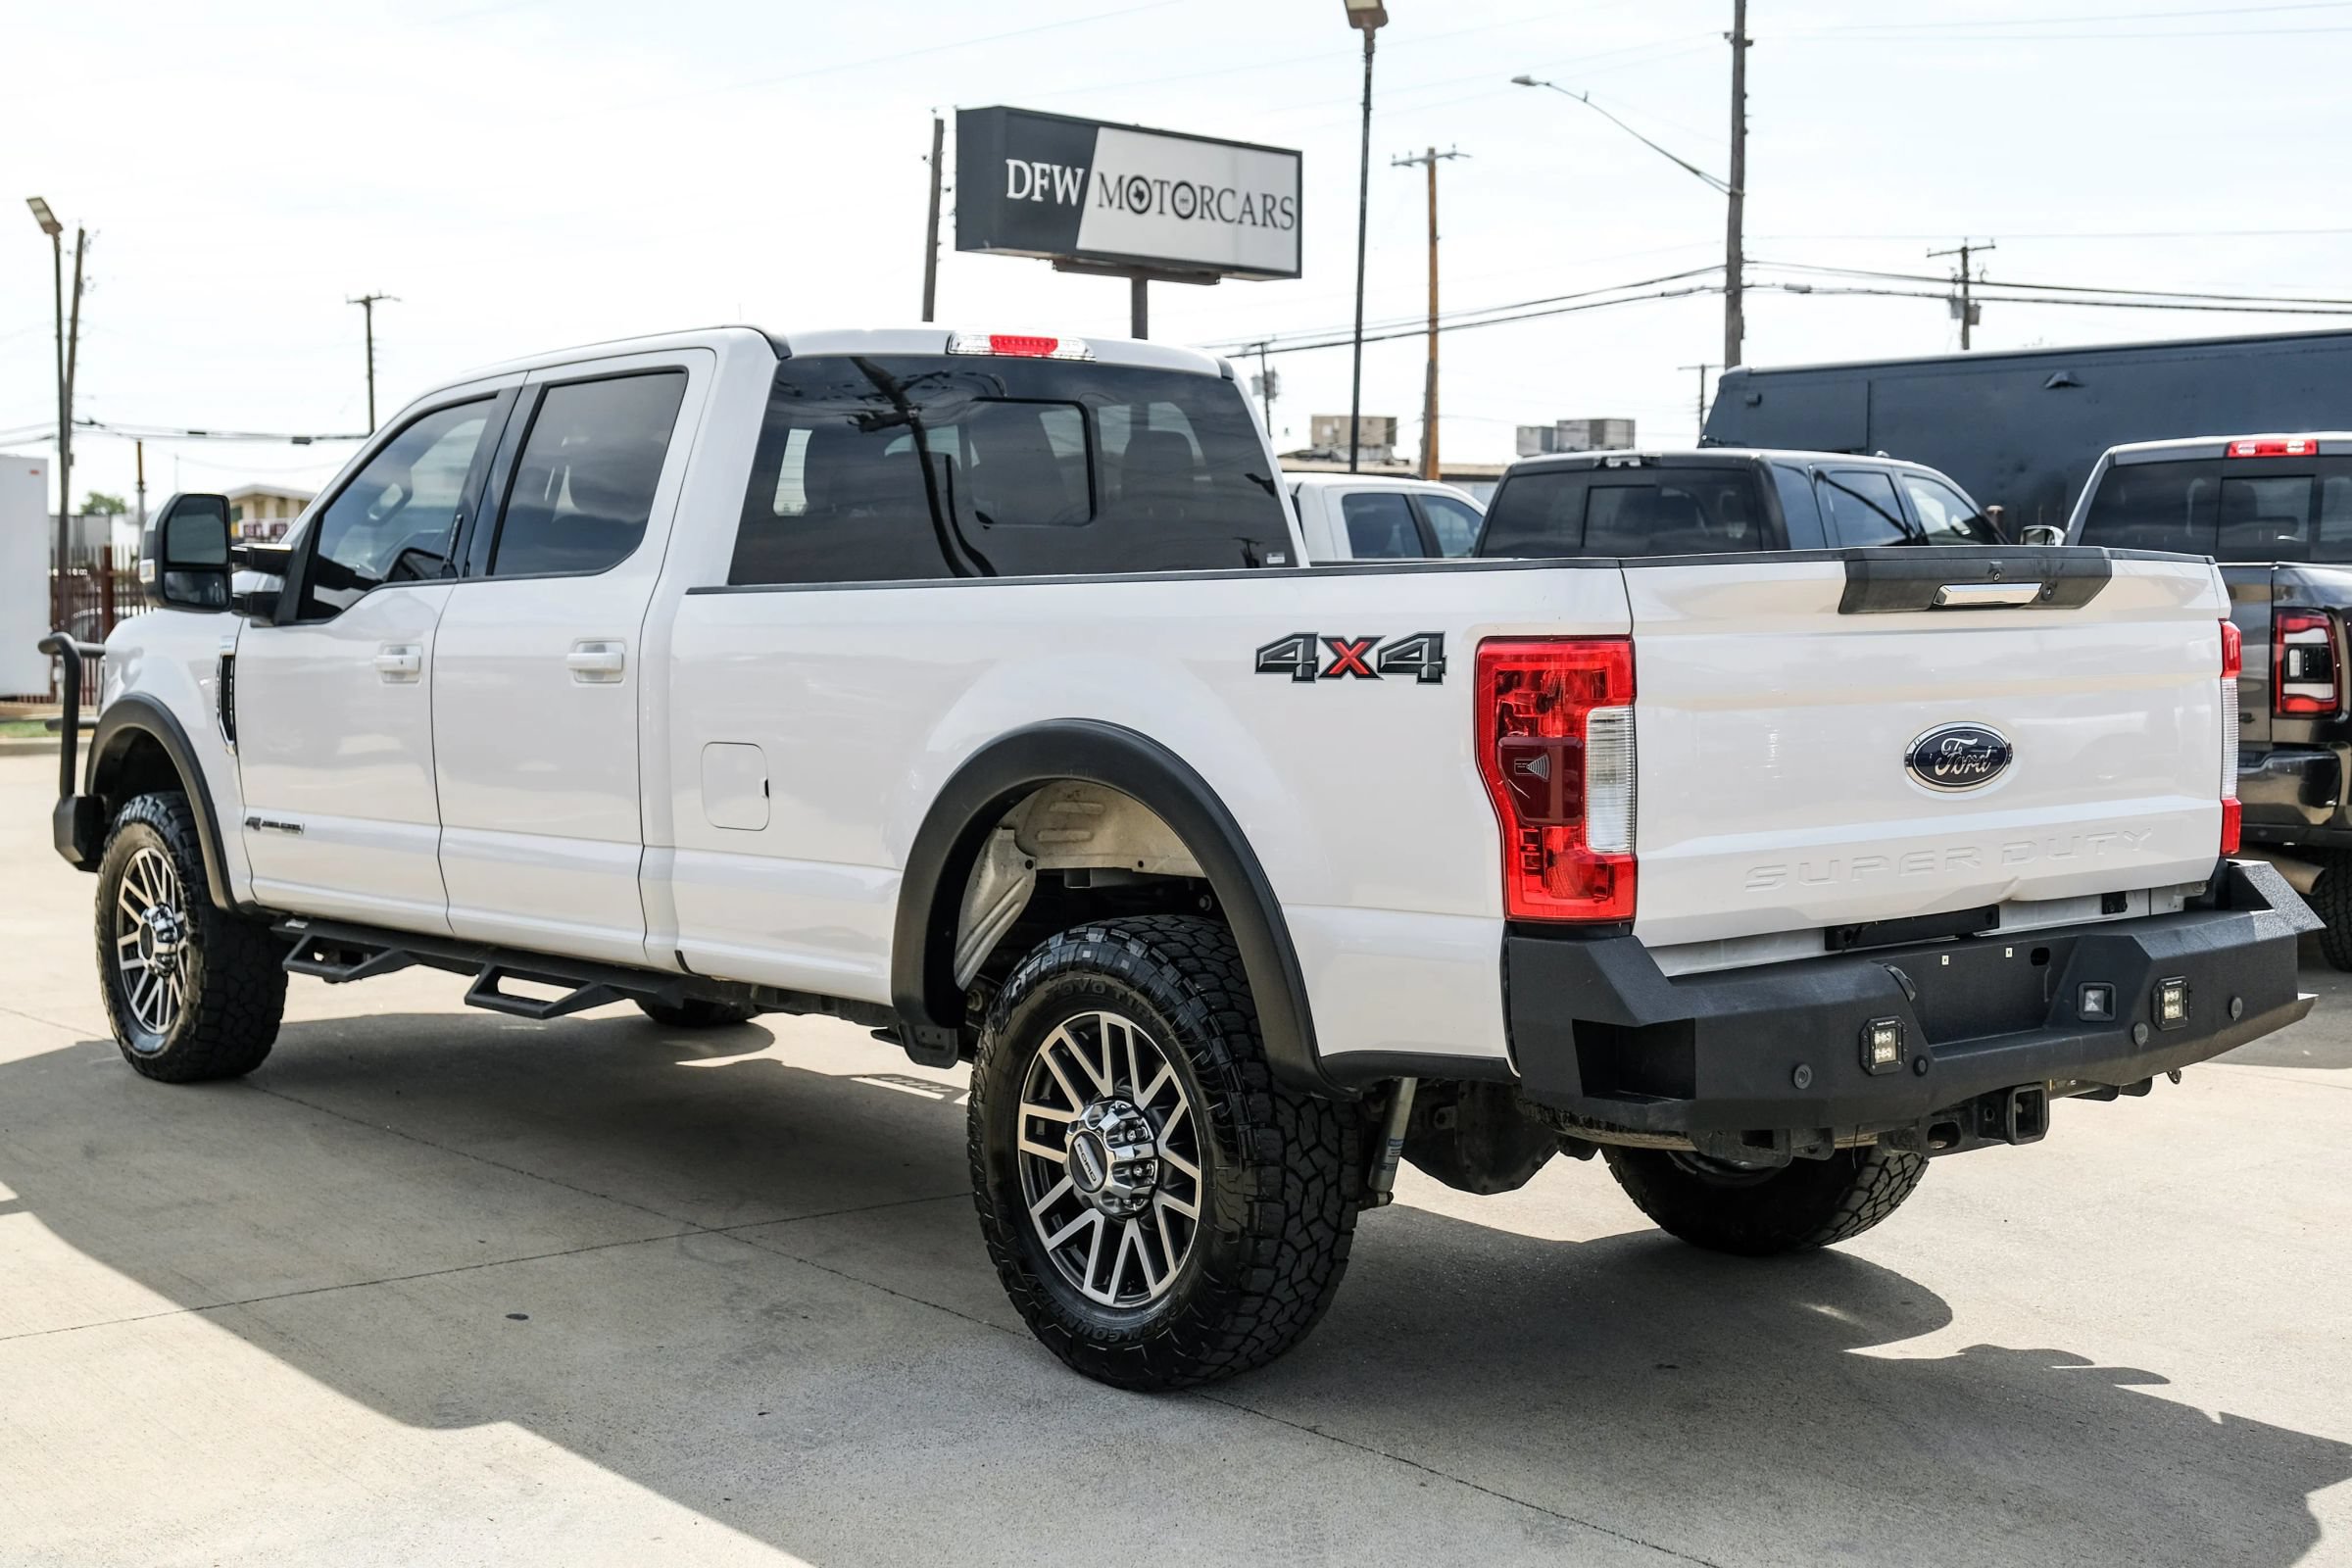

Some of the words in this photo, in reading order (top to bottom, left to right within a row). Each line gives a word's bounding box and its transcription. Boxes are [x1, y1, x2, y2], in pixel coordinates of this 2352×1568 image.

[1005, 158, 1085, 207] DFW
[1097, 172, 1295, 231] MOTORCARS
[1935, 737, 1991, 776] Ford
[1744, 844, 1983, 893] SUPER
[2000, 827, 2153, 866] DUTY
[1077, 1143, 1098, 1182] FORD
